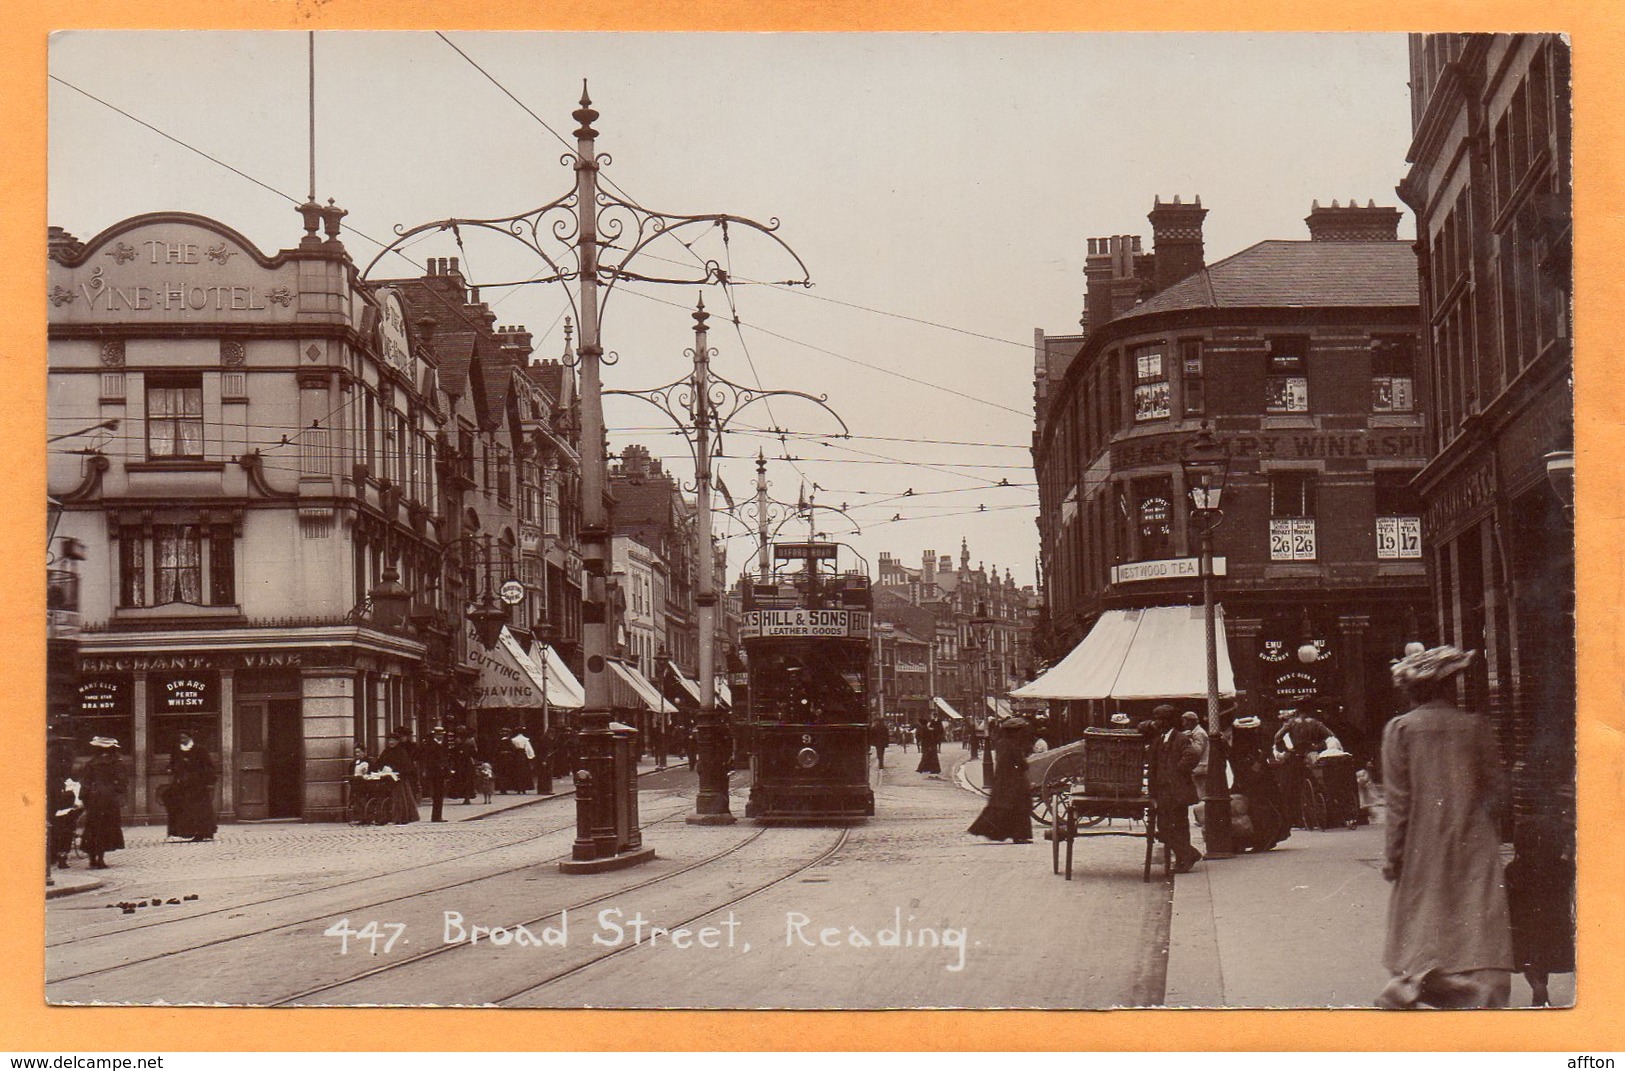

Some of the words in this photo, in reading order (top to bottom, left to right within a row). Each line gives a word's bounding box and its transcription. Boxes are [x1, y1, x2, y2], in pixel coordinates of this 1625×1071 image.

[143, 240, 200, 265] THE
[164, 282, 267, 311] HOTEL
[1293, 436, 1361, 457] WINE
[1120, 564, 1167, 579] WESTWOOD
[1171, 562, 1195, 574] TEA
[882, 573, 911, 586] HILL
[763, 611, 793, 626] HILL
[796, 613, 805, 626] &
[809, 611, 847, 626] SONS
[1265, 641, 1282, 649] EMU
[1259, 652, 1289, 662] BURGUNDY
[469, 651, 521, 681] CUTTING
[167, 680, 206, 691] DEWARS
[474, 686, 532, 698] SHAVING
[168, 698, 204, 706] WHISKY
[802, 734, 812, 744] 9
